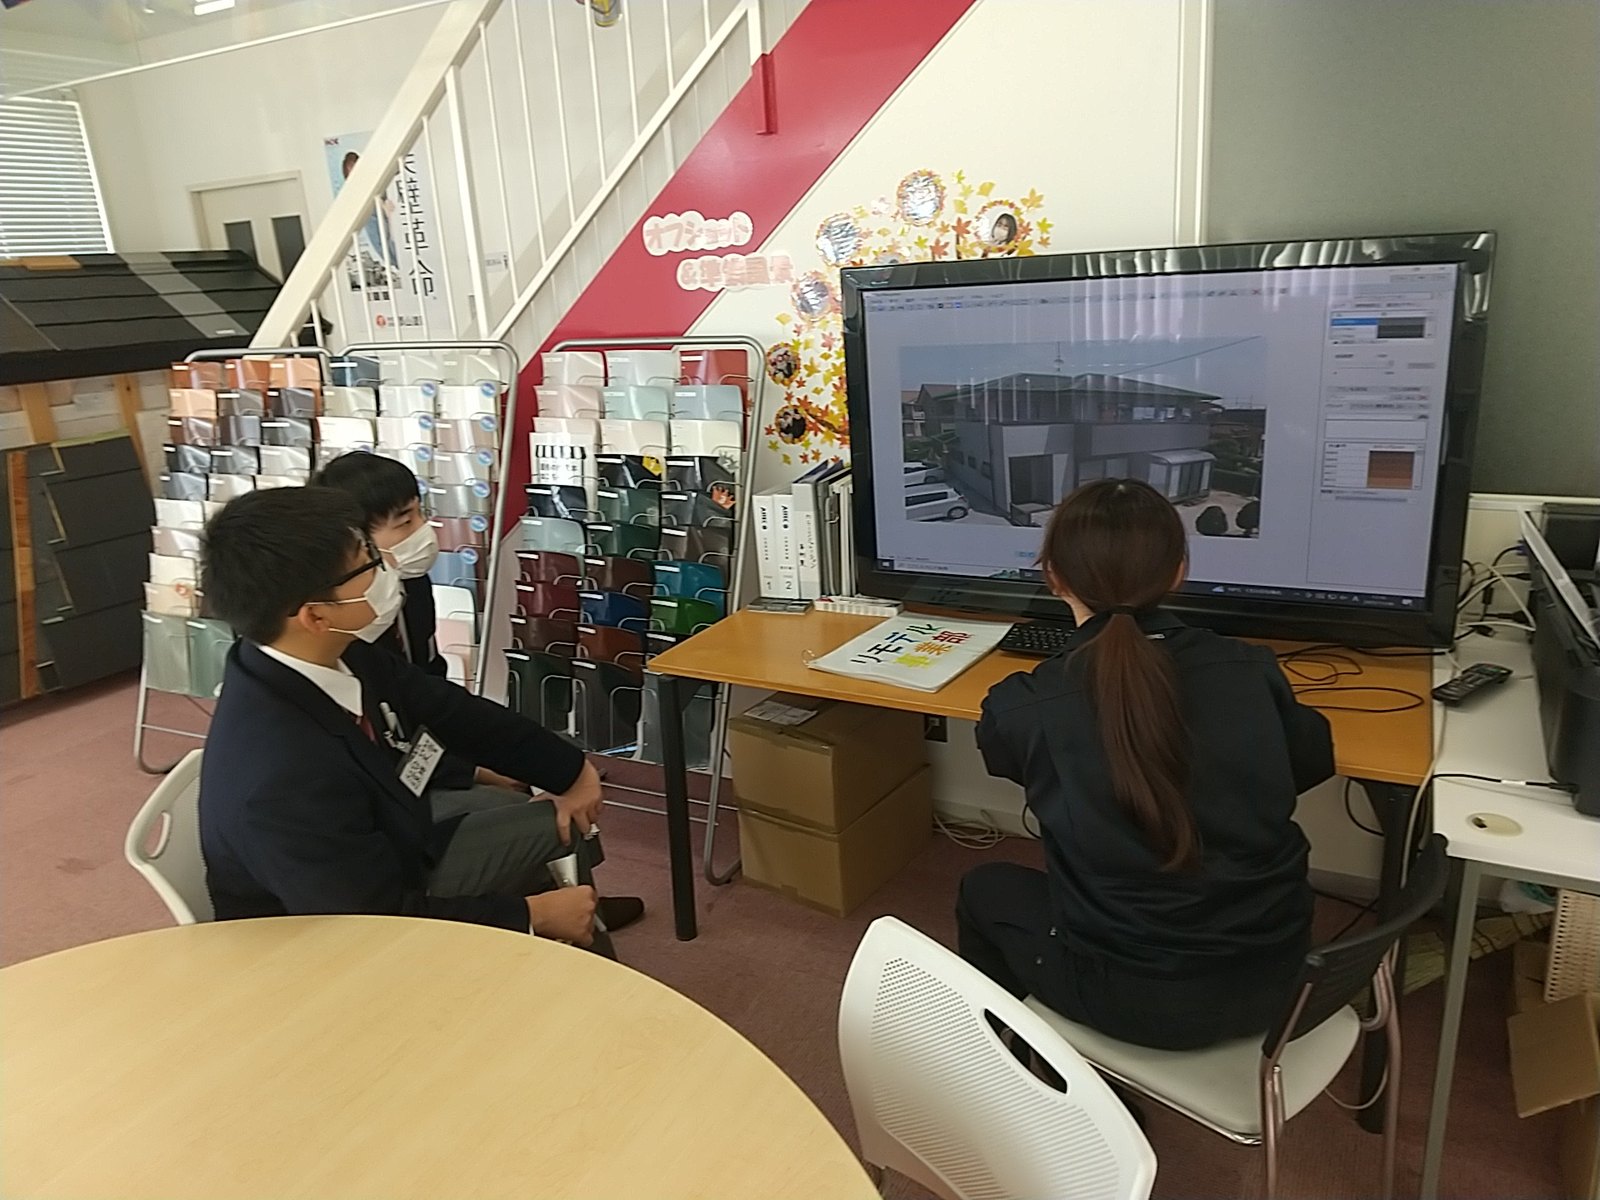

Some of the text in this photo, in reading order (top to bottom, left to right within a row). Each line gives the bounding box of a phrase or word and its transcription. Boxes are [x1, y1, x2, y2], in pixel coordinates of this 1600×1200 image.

[645, 215, 750, 250] オフショット
[785, 580, 793, 590] 2
[850, 623, 942, 664] リモデル
